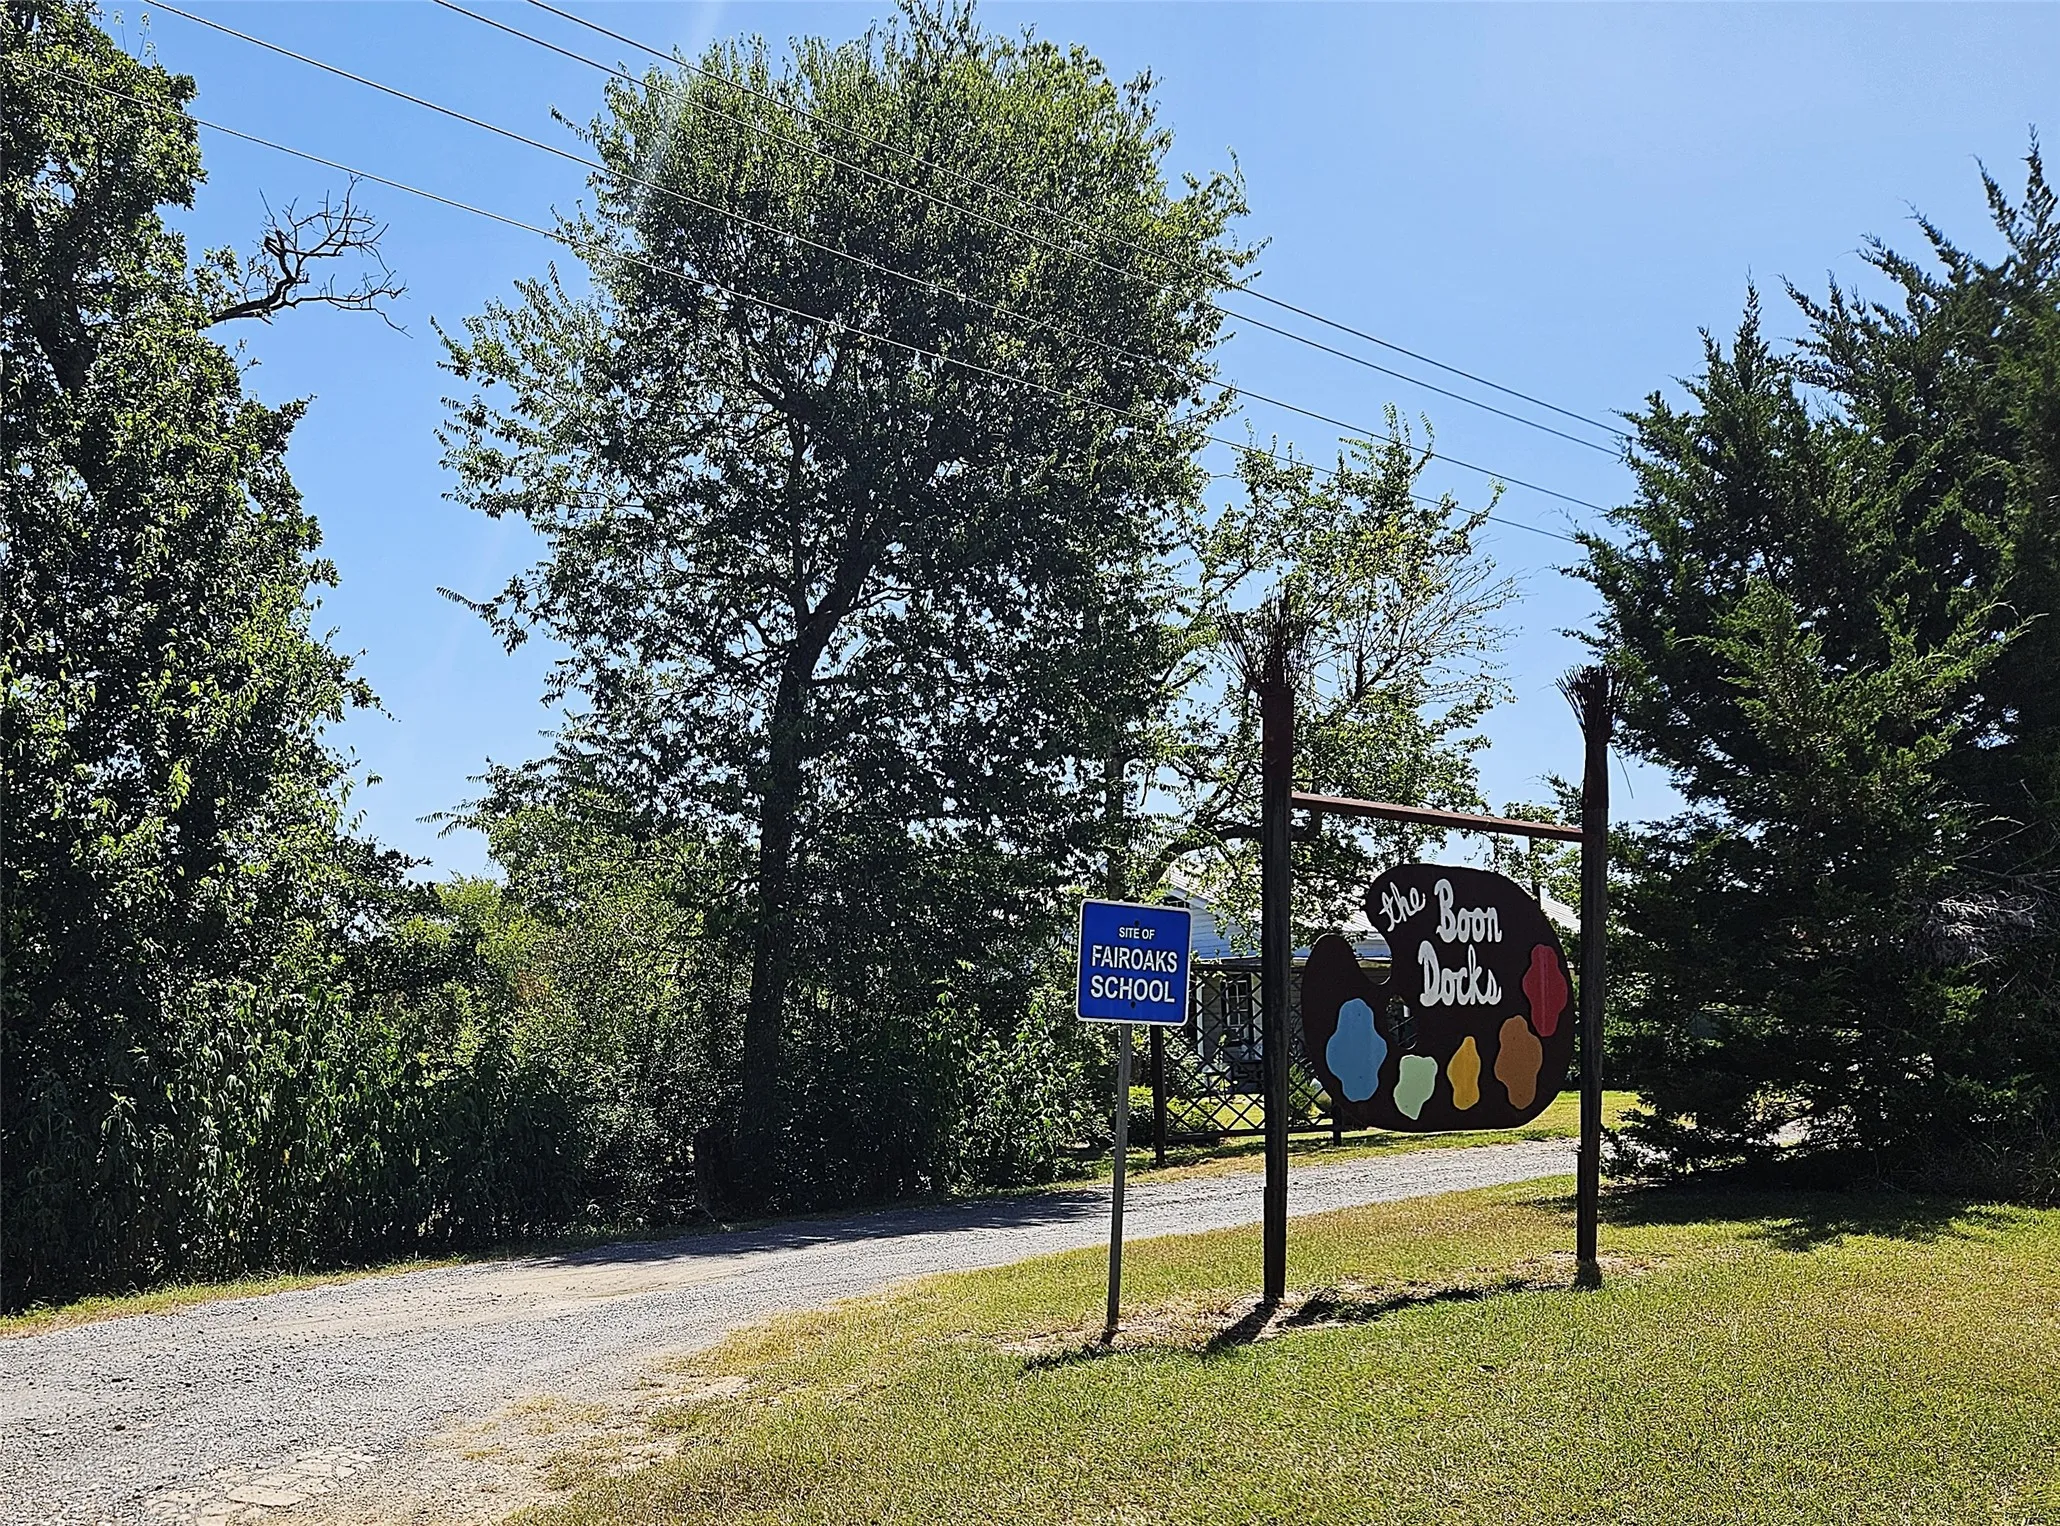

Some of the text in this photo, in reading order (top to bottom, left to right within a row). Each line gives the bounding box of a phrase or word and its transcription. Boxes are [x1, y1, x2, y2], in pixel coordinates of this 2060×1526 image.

[1378, 878, 1502, 943] the Boon
[1118, 926, 1156, 940] SITE OF
[1091, 944, 1178, 973] FAIROAKS
[1417, 940, 1502, 1007] Docks
[1090, 975, 1176, 1003] SCHOOL
